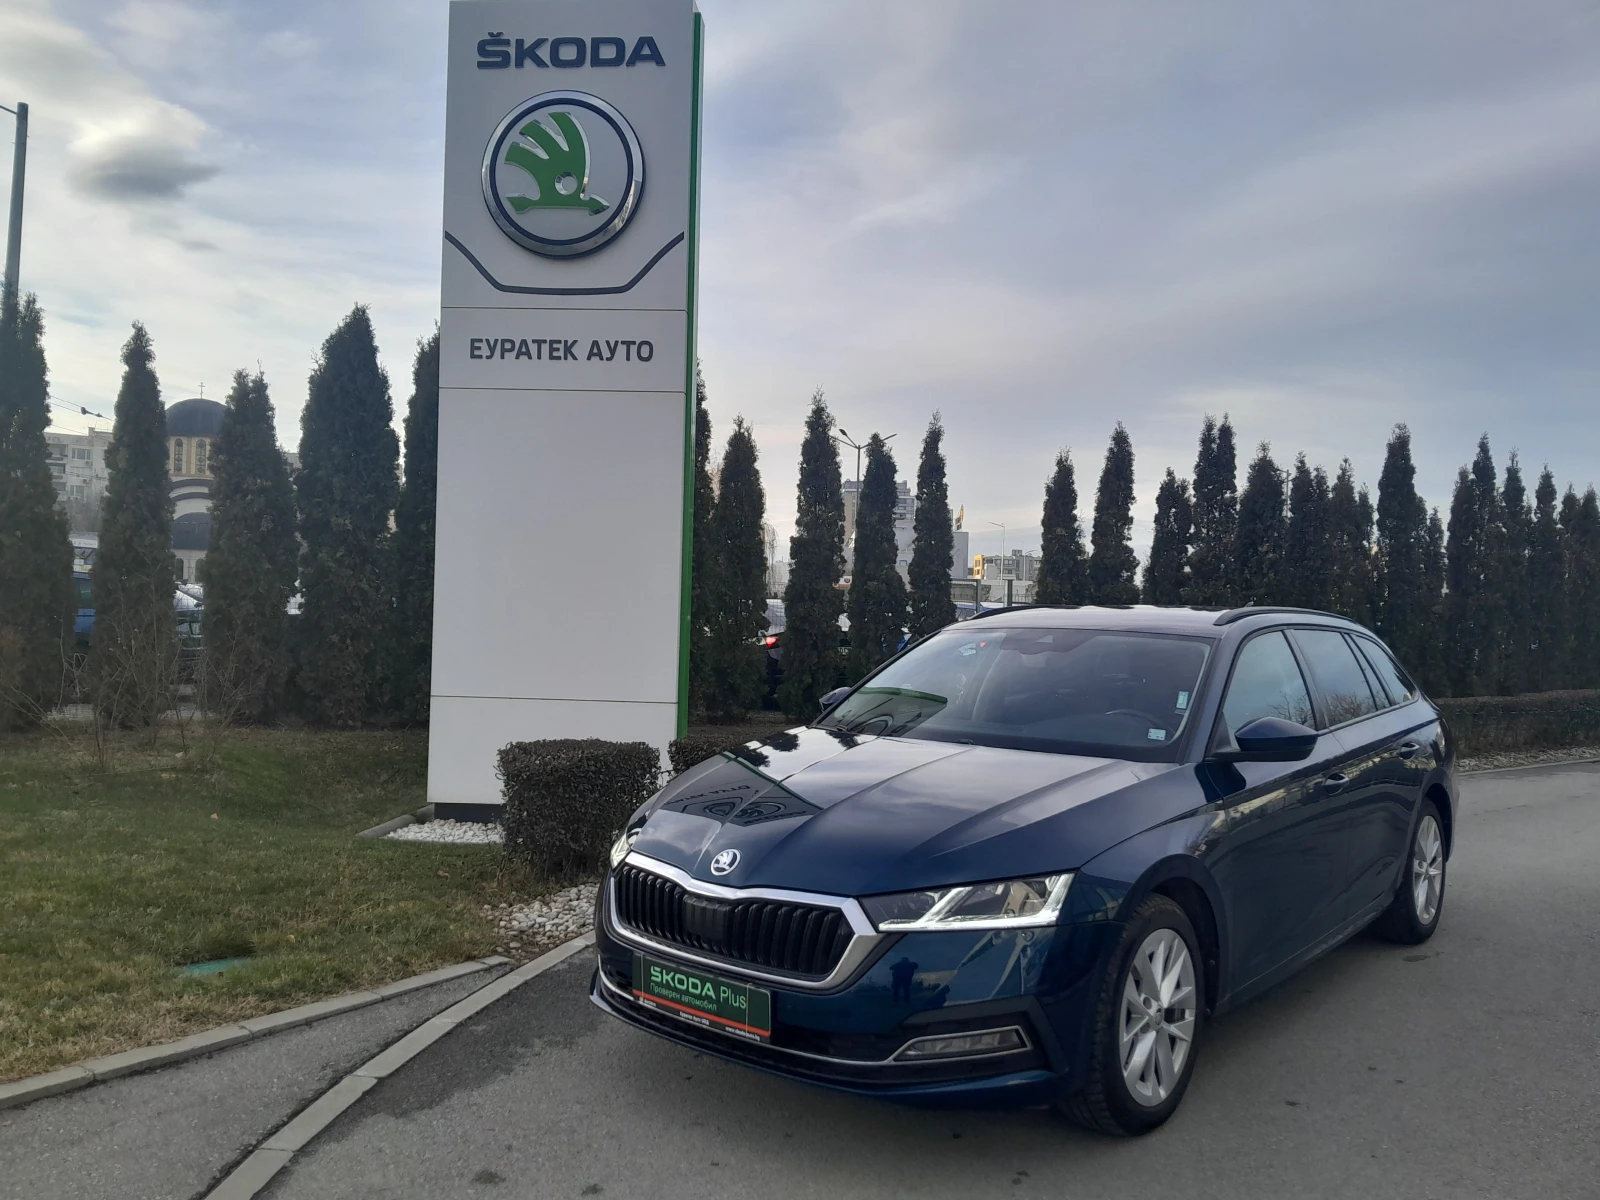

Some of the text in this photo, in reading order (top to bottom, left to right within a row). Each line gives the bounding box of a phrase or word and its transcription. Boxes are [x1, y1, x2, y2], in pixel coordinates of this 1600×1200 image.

[476, 31, 666, 69] ŠKODA
[469, 337, 654, 362] ЕУРАТЕК АУТО
[650, 982, 717, 1011] Проверен автомобил
[720, 985, 747, 1009] Plus
